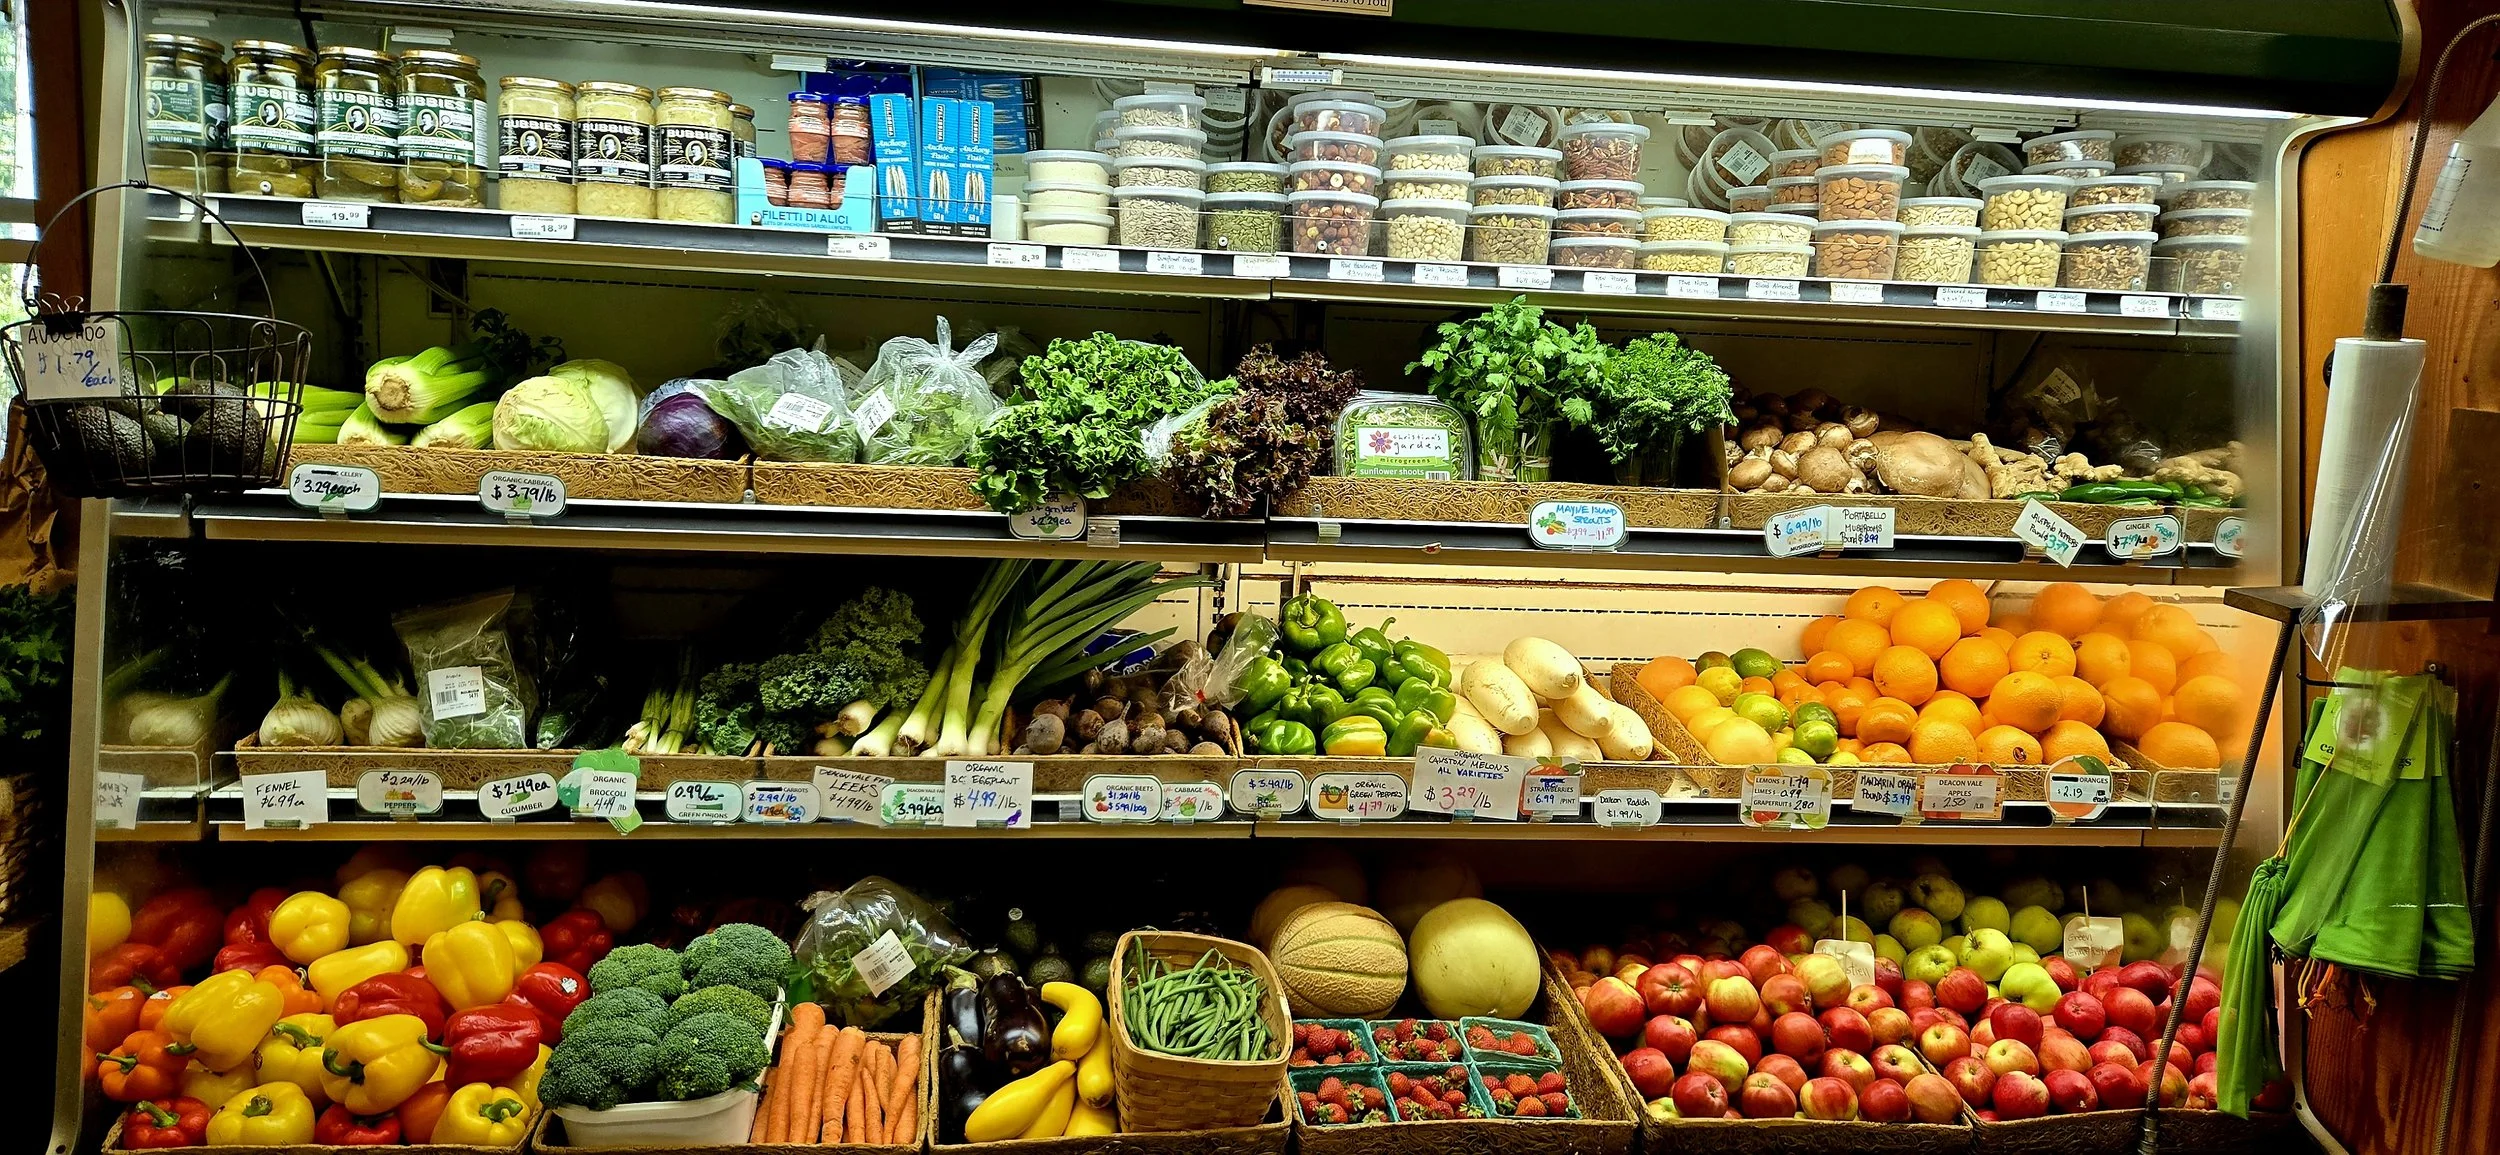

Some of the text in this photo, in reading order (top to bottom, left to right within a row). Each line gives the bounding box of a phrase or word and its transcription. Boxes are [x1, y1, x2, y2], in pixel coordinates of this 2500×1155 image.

[762, 210, 849, 225] FILETTI DI ALICI
[858, 241, 878, 251] 6.29
[1021, 254, 1040, 263] 8.39
[1392, 432, 1441, 441] christina's
[1394, 440, 1442, 455] garden
[1380, 457, 1431, 465] microgreens
[341, 470, 363, 478] CELERY
[1360, 467, 1425, 476] sunflower shoots
[493, 475, 554, 487] ORGANIC CABBAGE
[1592, 505, 1618, 516] ISLAND
[1573, 516, 1611, 525] SPROUTS
[2125, 523, 2150, 531] GINGER
[1790, 542, 1822, 552] MUSHROOMS
[1454, 750, 1483, 761] ORGANIC
[966, 763, 1004, 773] ORGANIC
[1429, 756, 1510, 773] CAWSTON MELONS
[819, 768, 850, 779] DEACON
[1438, 766, 1504, 780] ALL VARIETIES
[592, 775, 627, 784] ORGANIC
[972, 775, 1020, 786] EGGPLANT
[1860, 775, 1895, 790] MANDARIN
[256, 780, 301, 796] FENNEL
[589, 788, 627, 797] BROCCOLI
[829, 779, 879, 798] LEEKS
[2063, 785, 2083, 798] 2.19
[967, 789, 997, 810] 4.99
[1350, 790, 1403, 798] GREEN PEPPERS
[1535, 793, 1555, 804] 6.99
[1862, 788, 1882, 801] POUND
[1600, 796, 1650, 806] Daikon Radish
[1753, 799, 1788, 807] GRAPEFRUIT
[1943, 797, 1966, 808] 2.50
[501, 802, 543, 815] CUCUMBER
